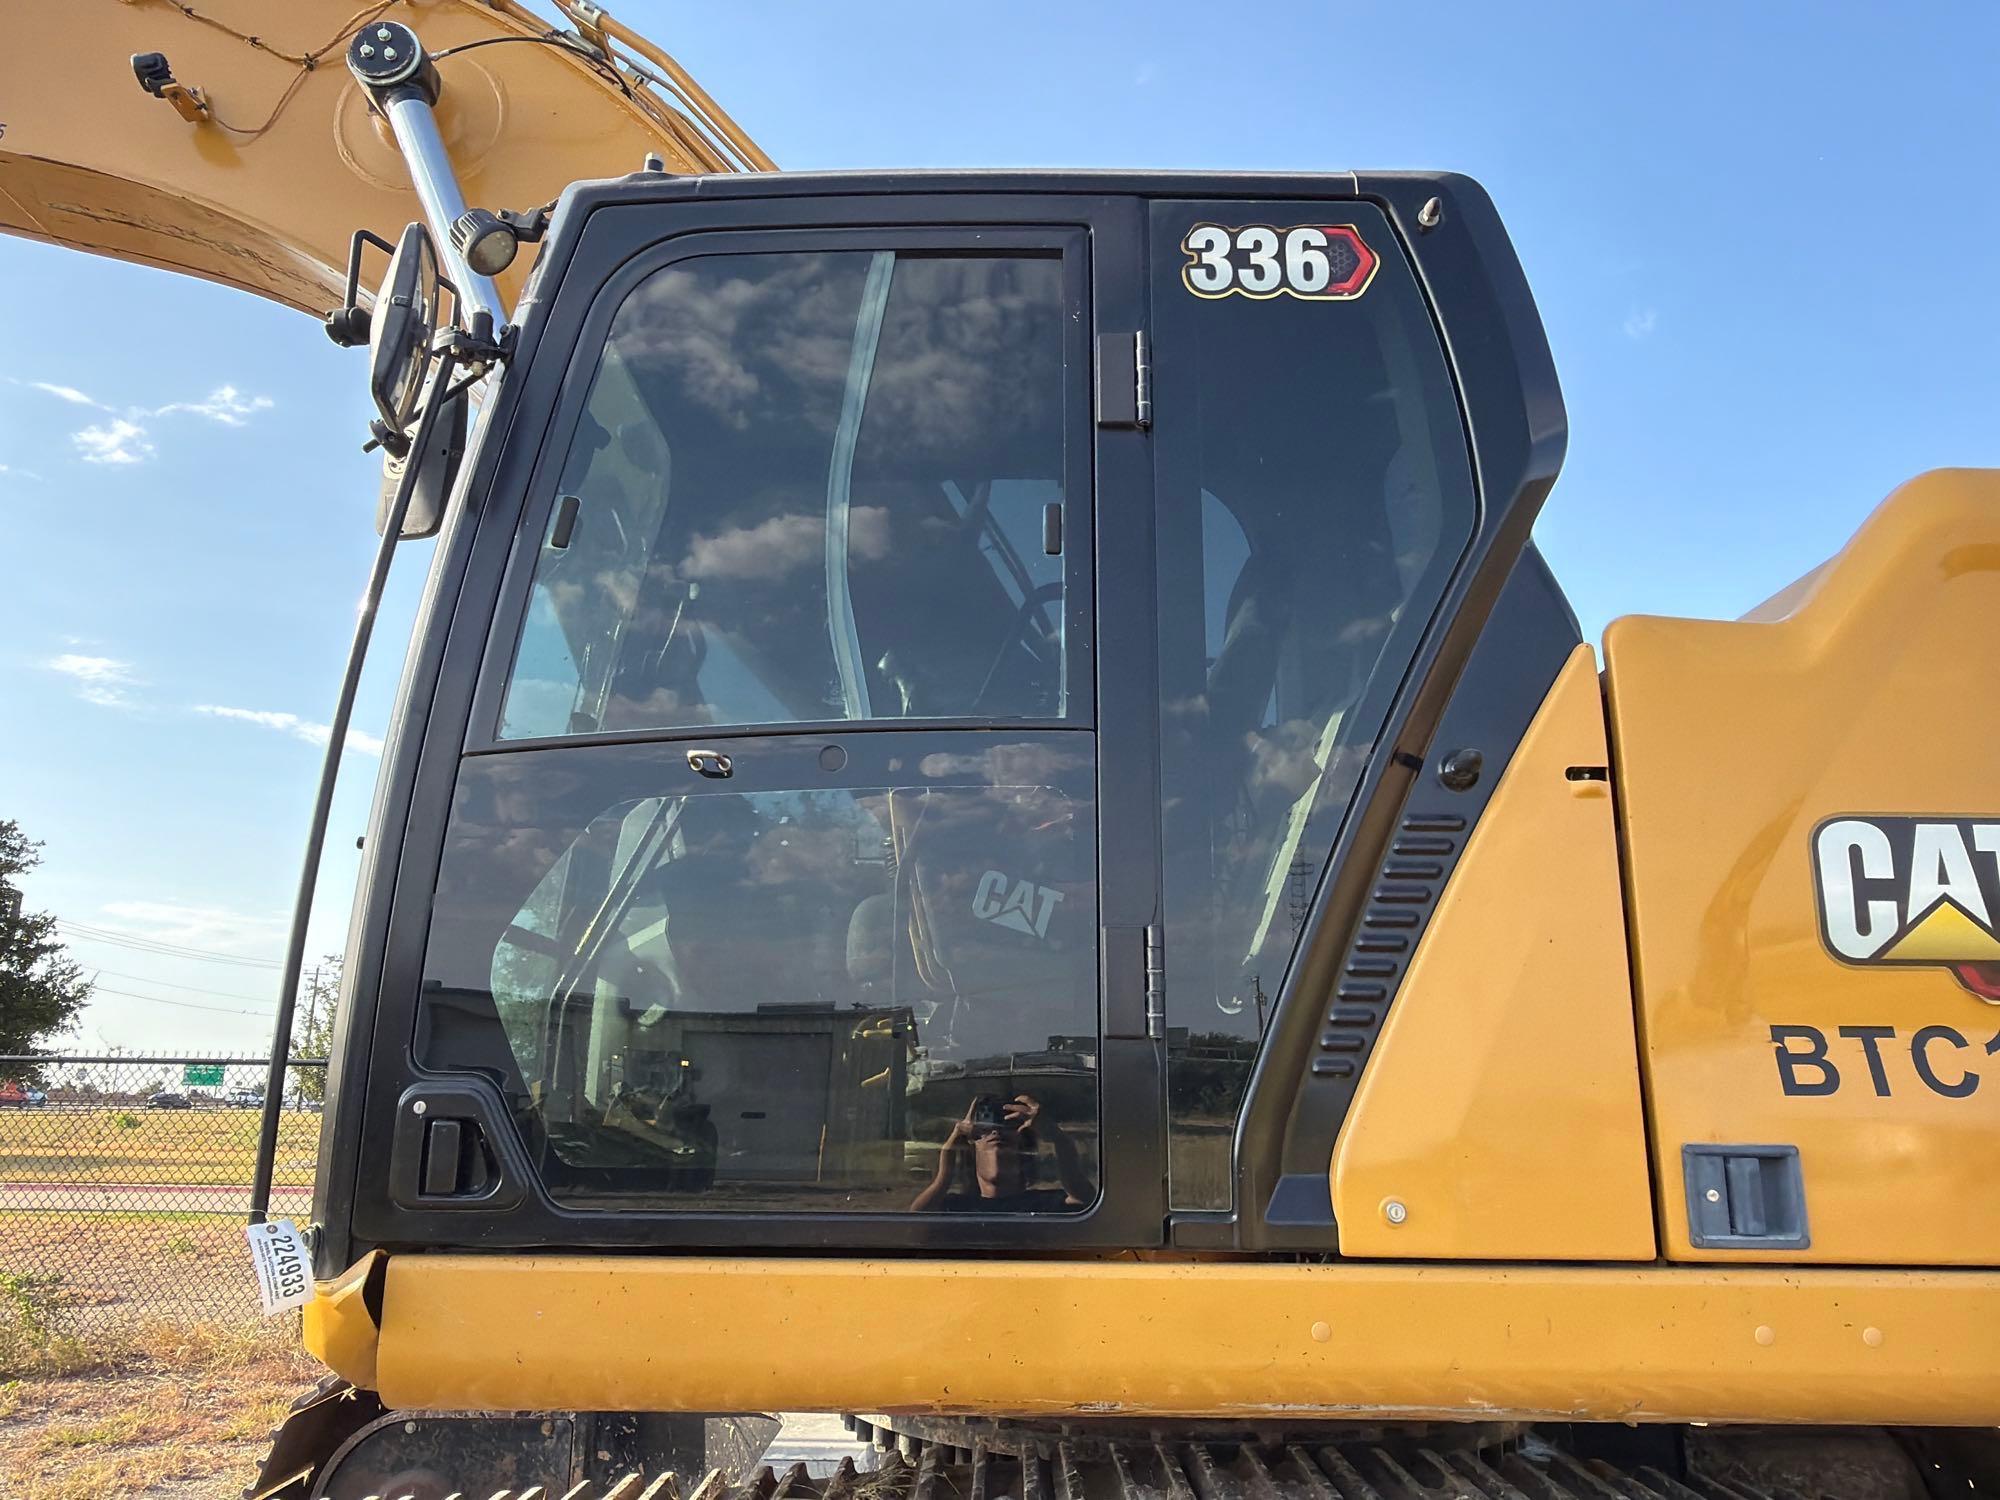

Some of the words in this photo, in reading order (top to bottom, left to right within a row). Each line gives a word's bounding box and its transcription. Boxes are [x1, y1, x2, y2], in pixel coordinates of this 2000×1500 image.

[1188, 227, 1330, 292] 336
[972, 870, 1065, 939] CAT
[1770, 1025, 2000, 1098] BTC
[270, 1235, 305, 1298] 224933
